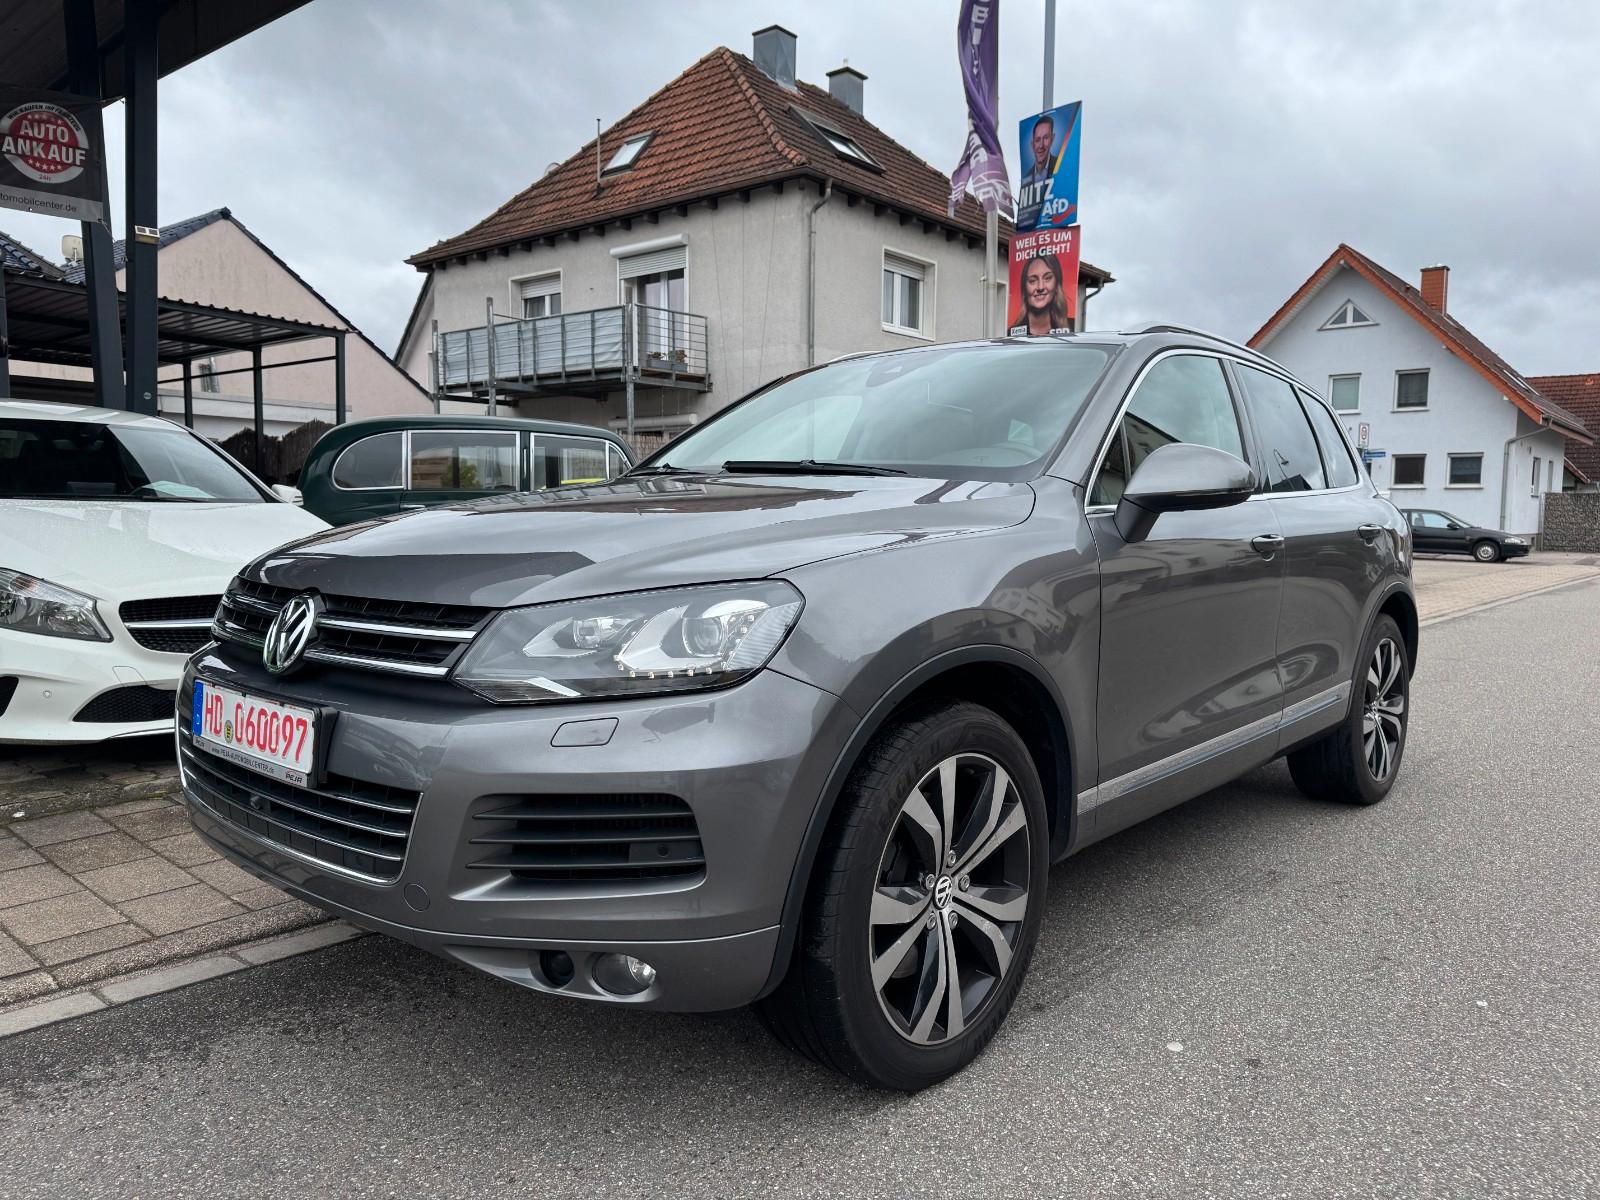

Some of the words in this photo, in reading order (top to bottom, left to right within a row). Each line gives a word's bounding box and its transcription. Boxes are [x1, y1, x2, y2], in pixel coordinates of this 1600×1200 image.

[20, 120, 69, 143] AUTO
[2, 136, 87, 166] ANKAUF
[1042, 197, 1068, 216] AfD
[1016, 237, 1037, 250] WEIL
[1039, 233, 1050, 245] ES
[1053, 231, 1072, 243] UM
[1016, 248, 1037, 261] DICH
[1039, 242, 1070, 257] GEHT!
[204, 691, 224, 737] HD
[234, 702, 308, 764] 060097
